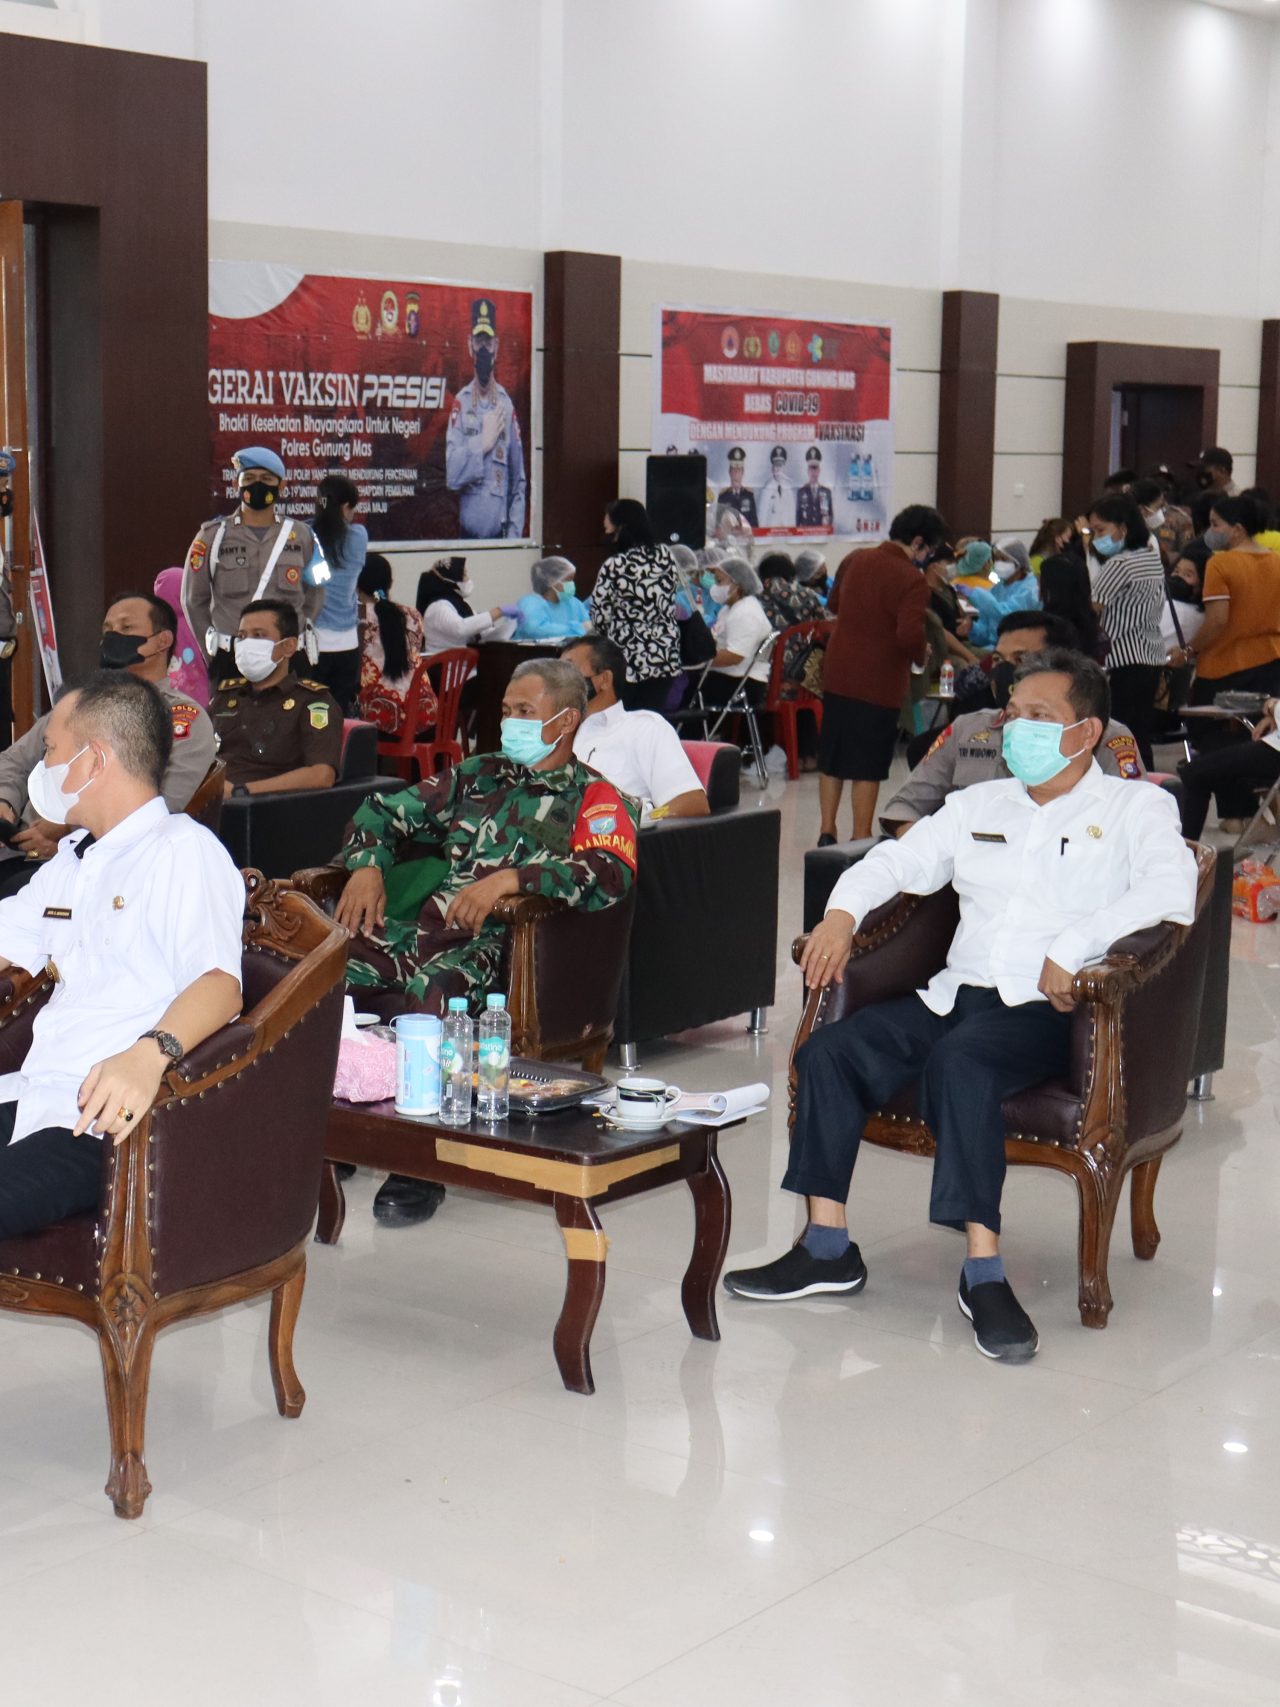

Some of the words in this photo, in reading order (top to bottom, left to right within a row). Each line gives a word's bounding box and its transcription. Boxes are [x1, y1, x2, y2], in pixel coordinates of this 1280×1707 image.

[208, 369, 274, 405] GERAI
[279, 371, 359, 408] VAKSIN
[362, 374, 447, 409] PRESISI
[774, 391, 820, 416] COVID-19
[219, 413, 249, 432] Bhakti
[251, 414, 301, 432] Kesehatan
[304, 415, 364, 437] Bhayangkara
[365, 416, 390, 433] Untuk
[392, 417, 421, 438] Negeri
[818, 422, 865, 442] VAKSINASI
[281, 438, 310, 457] Polres
[312, 440, 351, 461] Gunung
[353, 440, 372, 457] Mas
